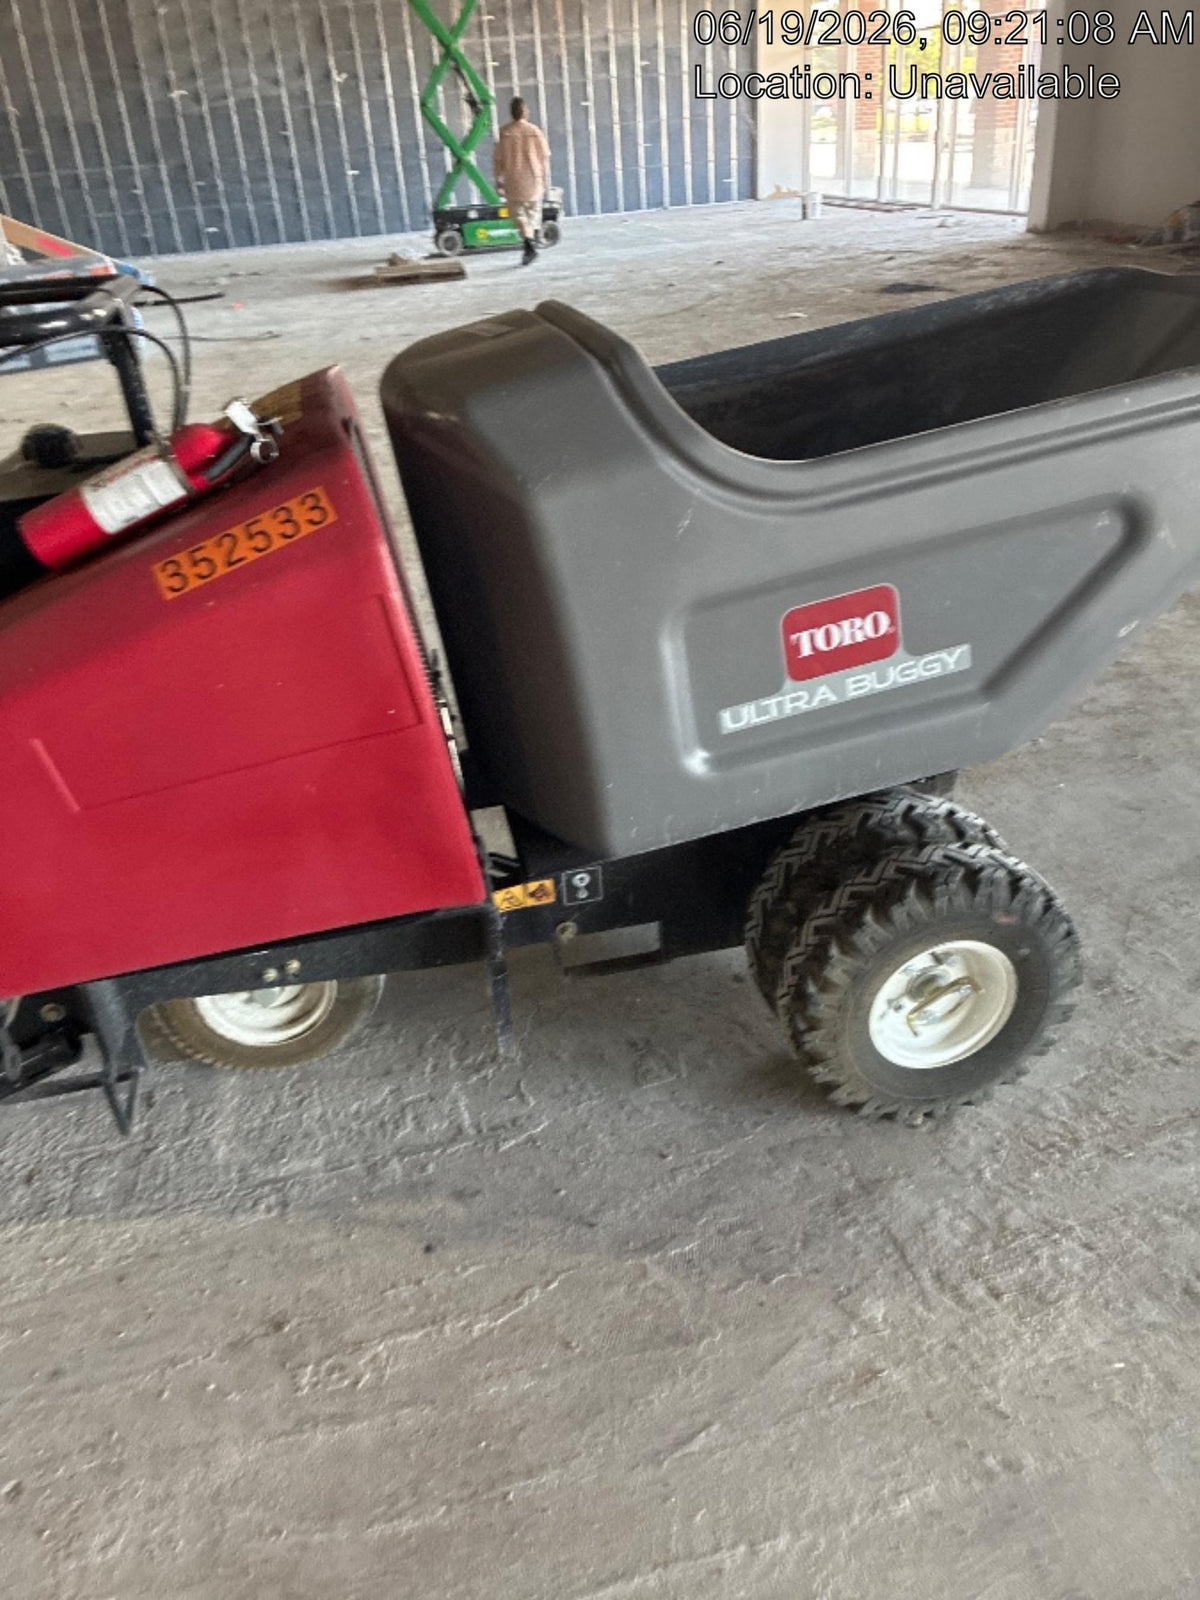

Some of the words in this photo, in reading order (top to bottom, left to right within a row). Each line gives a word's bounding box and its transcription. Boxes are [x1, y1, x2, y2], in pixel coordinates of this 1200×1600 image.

[160, 492, 330, 593] 352533
[790, 610, 891, 659] TORO
[722, 684, 838, 730] ULTRA
[845, 645, 965, 697] BUGGY
